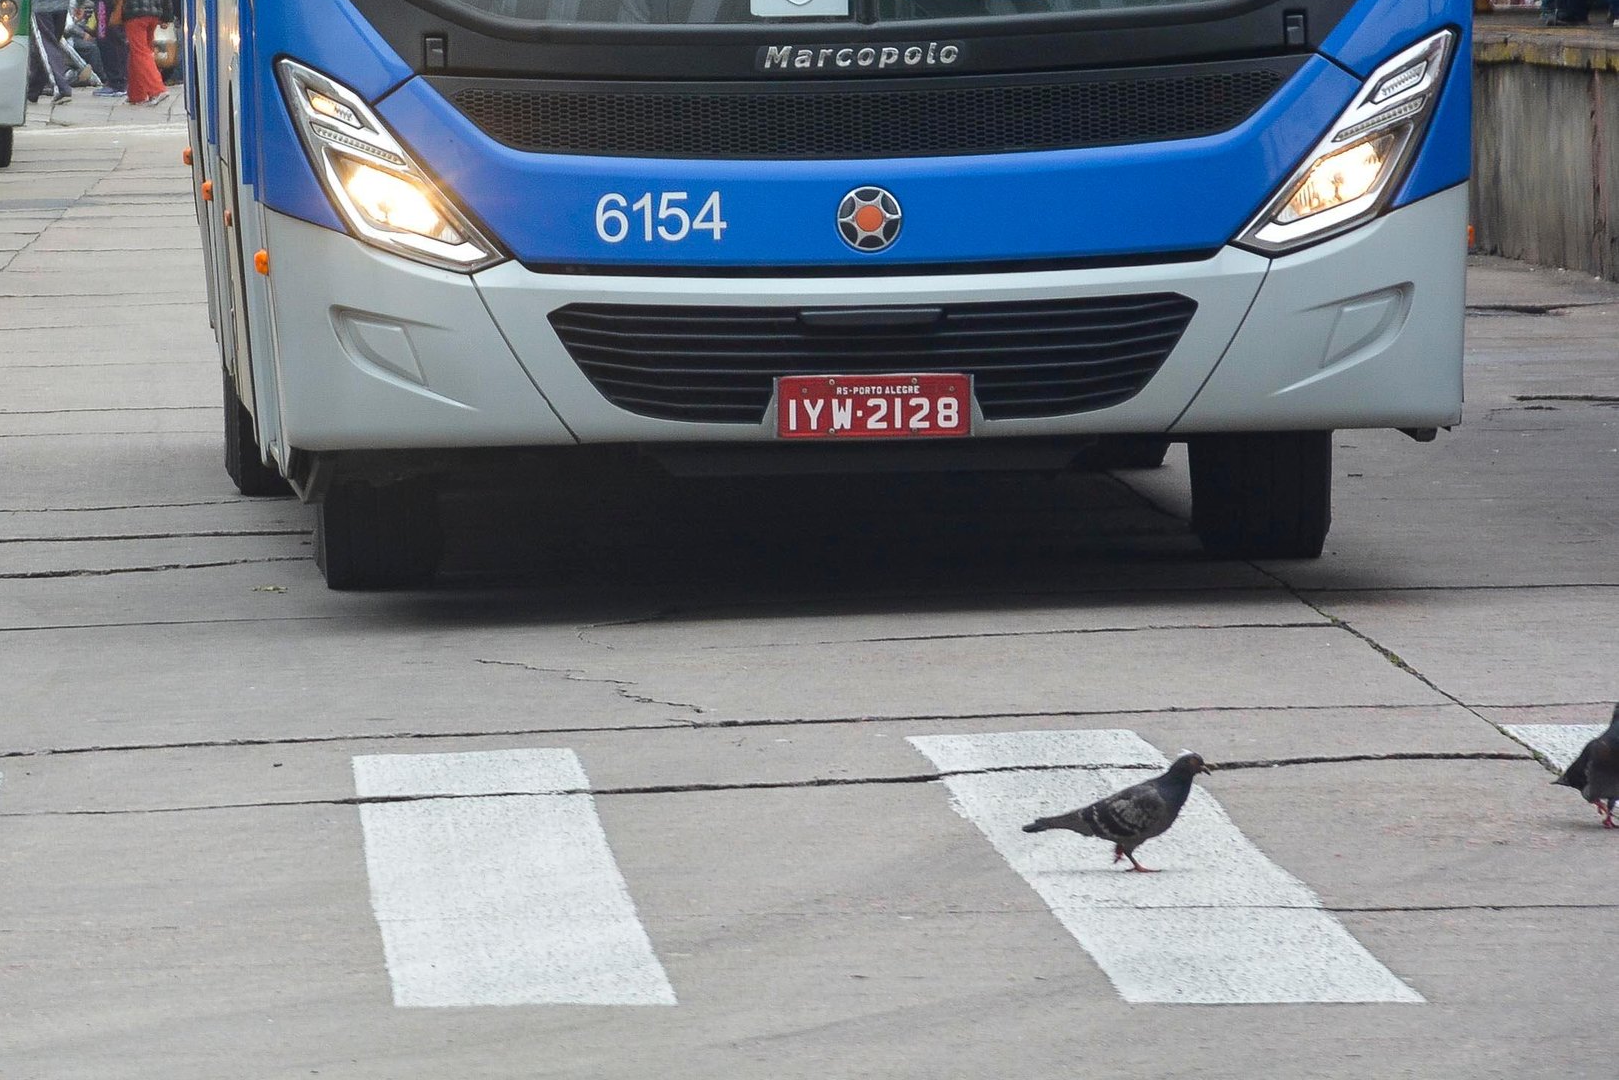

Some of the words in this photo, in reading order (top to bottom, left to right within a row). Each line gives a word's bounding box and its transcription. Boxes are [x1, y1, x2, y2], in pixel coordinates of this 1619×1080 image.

[764, 42, 959, 69] Marcopolo
[595, 191, 728, 243] 6154
[836, 386, 883, 395] RS-PORTO
[884, 385, 921, 394] ALEGRE
